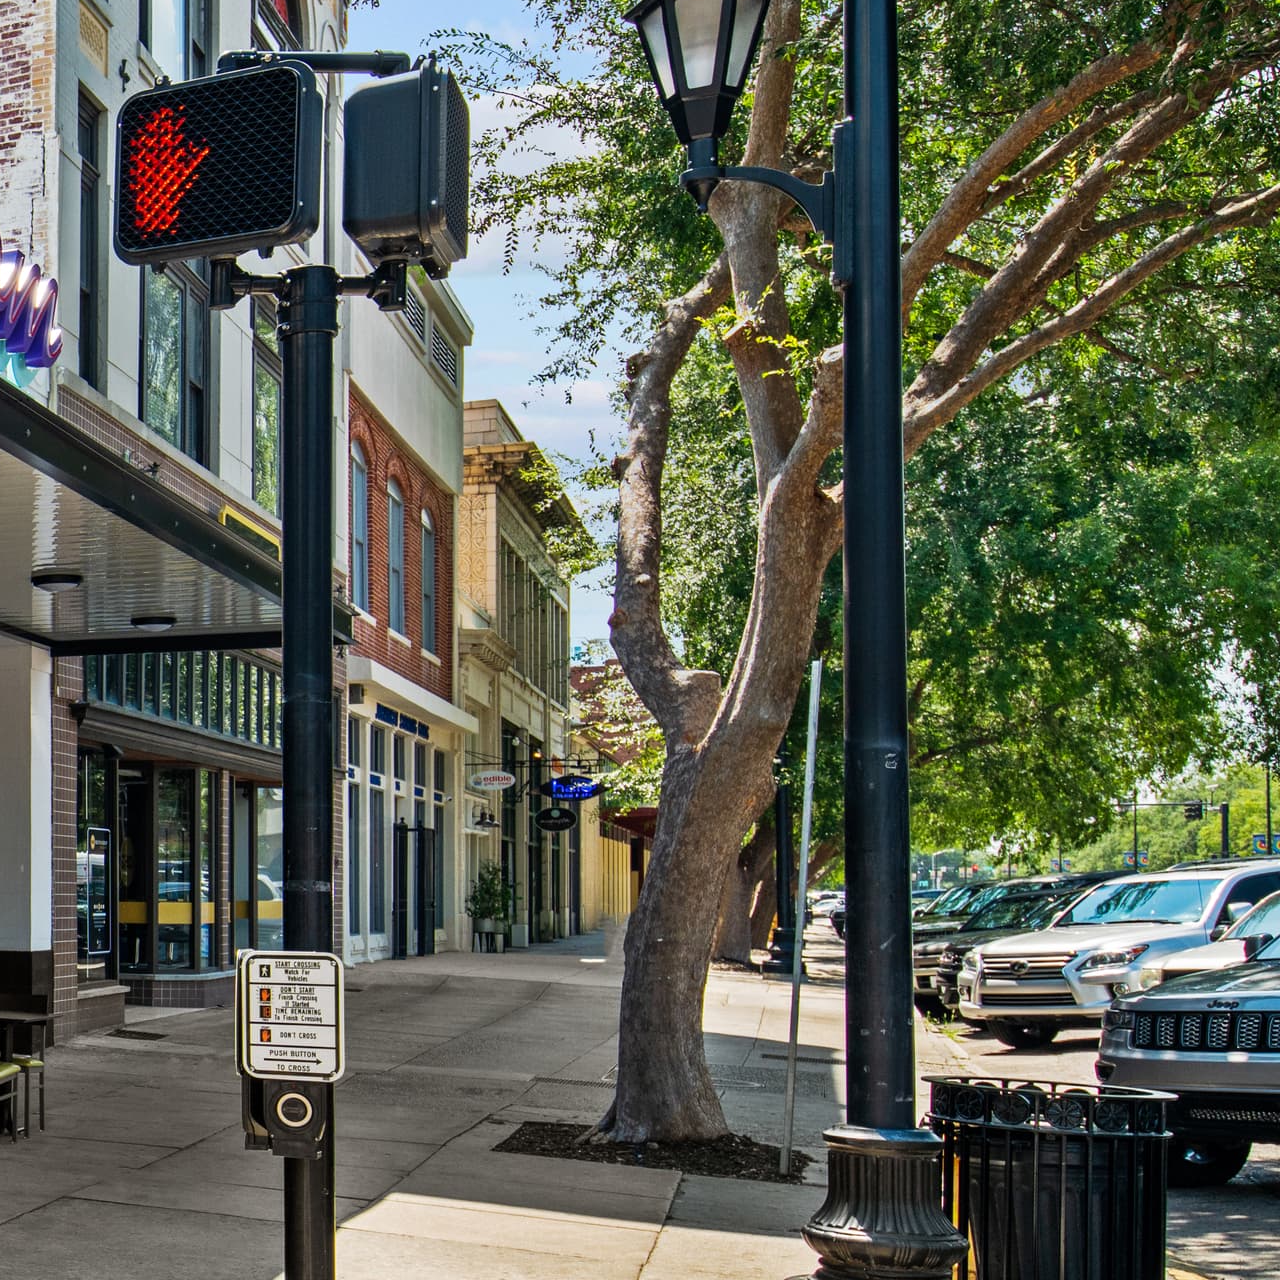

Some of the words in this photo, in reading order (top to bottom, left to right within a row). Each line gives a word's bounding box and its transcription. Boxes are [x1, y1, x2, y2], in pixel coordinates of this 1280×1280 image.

[483, 775, 512, 783] edible
[293, 961, 320, 969] CROSSING
[1207, 999, 1239, 1009] Jeep
[290, 1050, 317, 1058] BUTTON
[288, 1064, 311, 1072] CROSS
